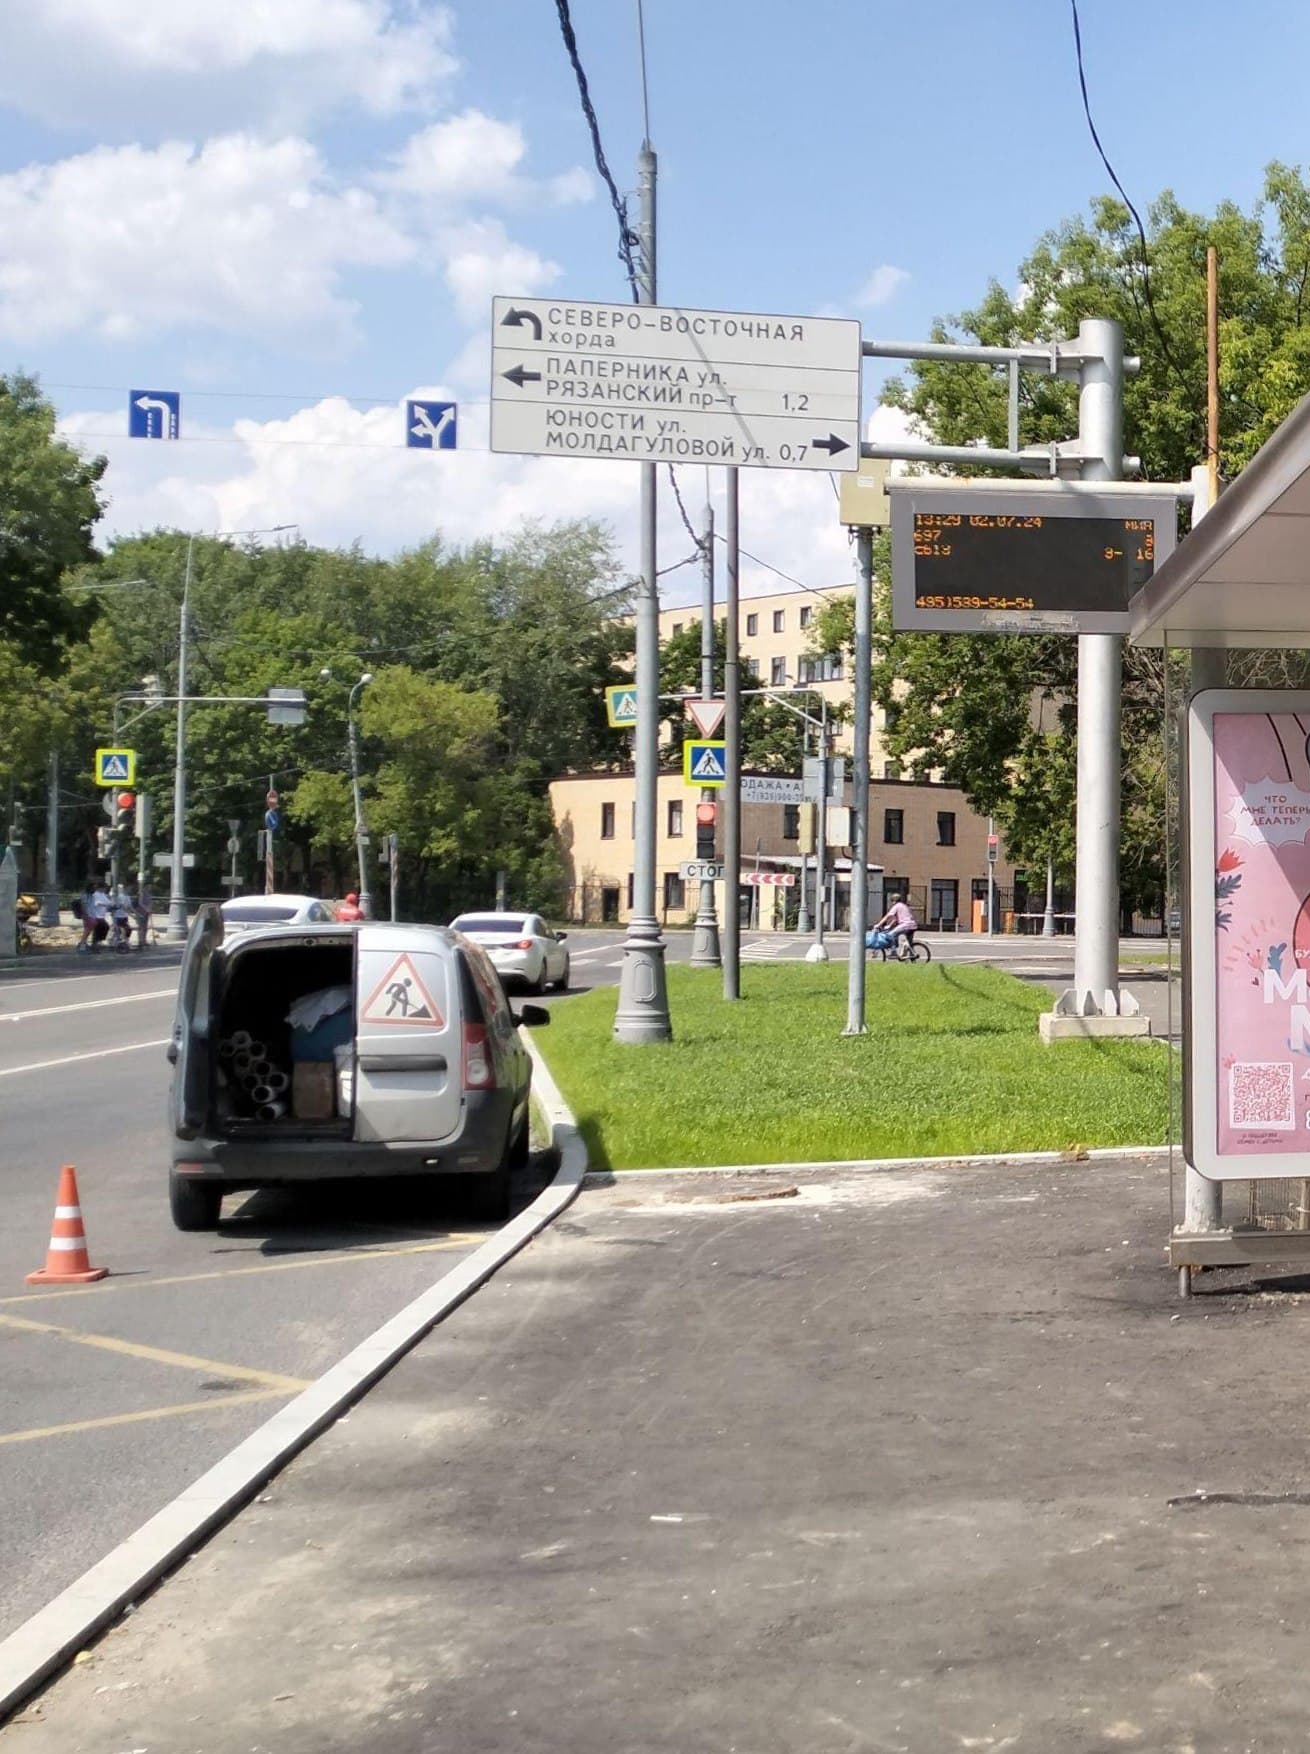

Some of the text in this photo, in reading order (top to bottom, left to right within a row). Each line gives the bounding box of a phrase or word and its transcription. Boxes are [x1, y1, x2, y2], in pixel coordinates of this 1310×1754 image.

[548, 307, 804, 341] СЕВЕРО-ВОСТОЧНАЯ
[548, 332, 616, 349] хорда
[547, 357, 728, 386] ПАПЕРНИКА ул.
[546, 380, 809, 412] РЯЗАНСКИЙ пр-т 1,2
[546, 409, 687, 435] ЮНОСТИ ул.
[546, 431, 808, 463] МОЛДАГУЛОВОЙ ул. 0,7
[1240, 806, 1310, 815] МНЕ ТЕПЕРЬ
[1264, 795, 1287, 803] ЧТО
